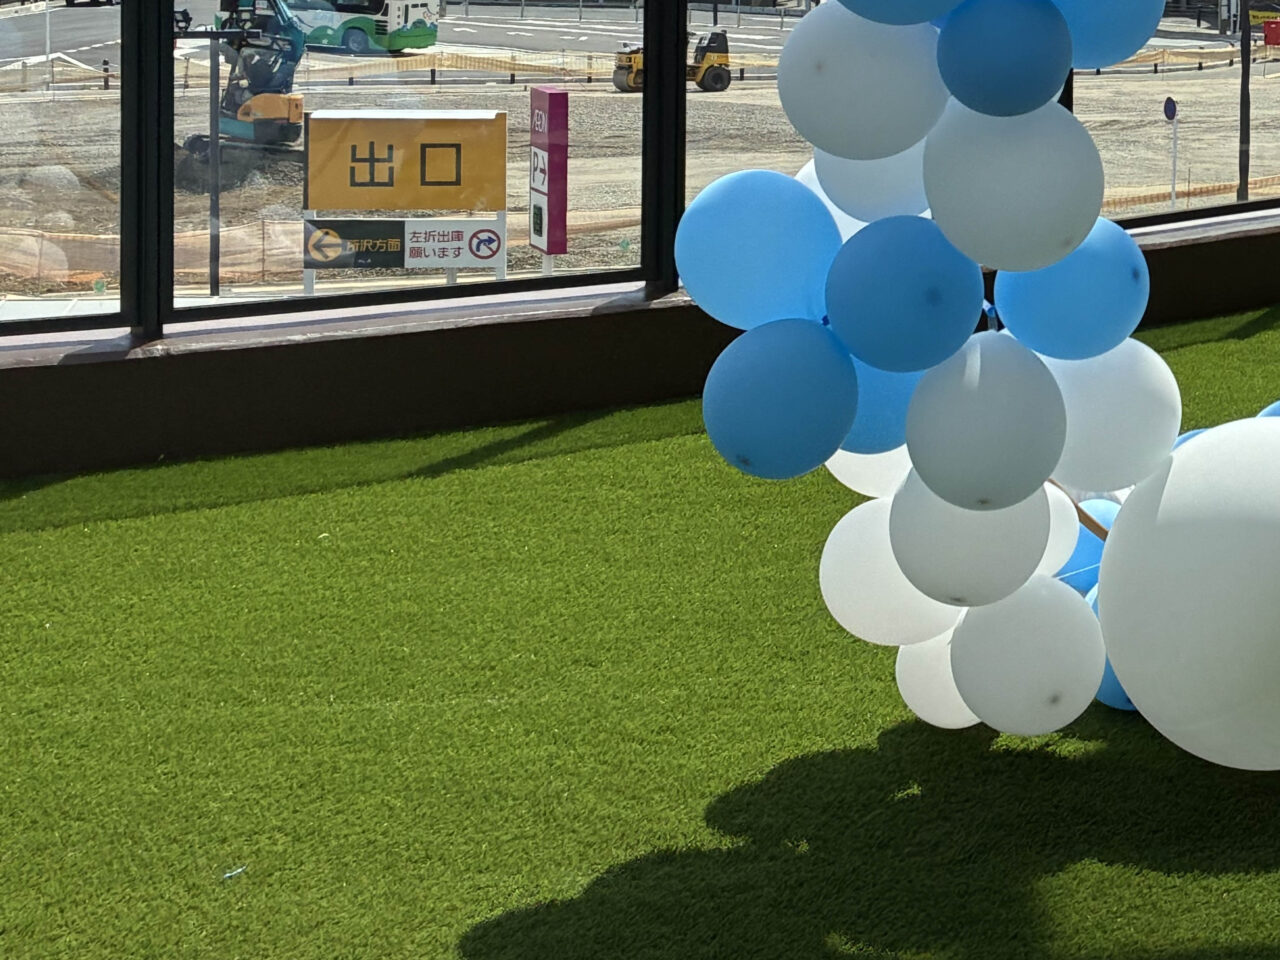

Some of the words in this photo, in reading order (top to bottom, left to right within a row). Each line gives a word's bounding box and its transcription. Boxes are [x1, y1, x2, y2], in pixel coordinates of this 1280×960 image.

[350, 141, 462, 187] 出口
[532, 151, 539, 186] P
[409, 230, 465, 244] 左折出庫
[346, 239, 401, 253] 所沢方面
[409, 246, 465, 260] 願います
